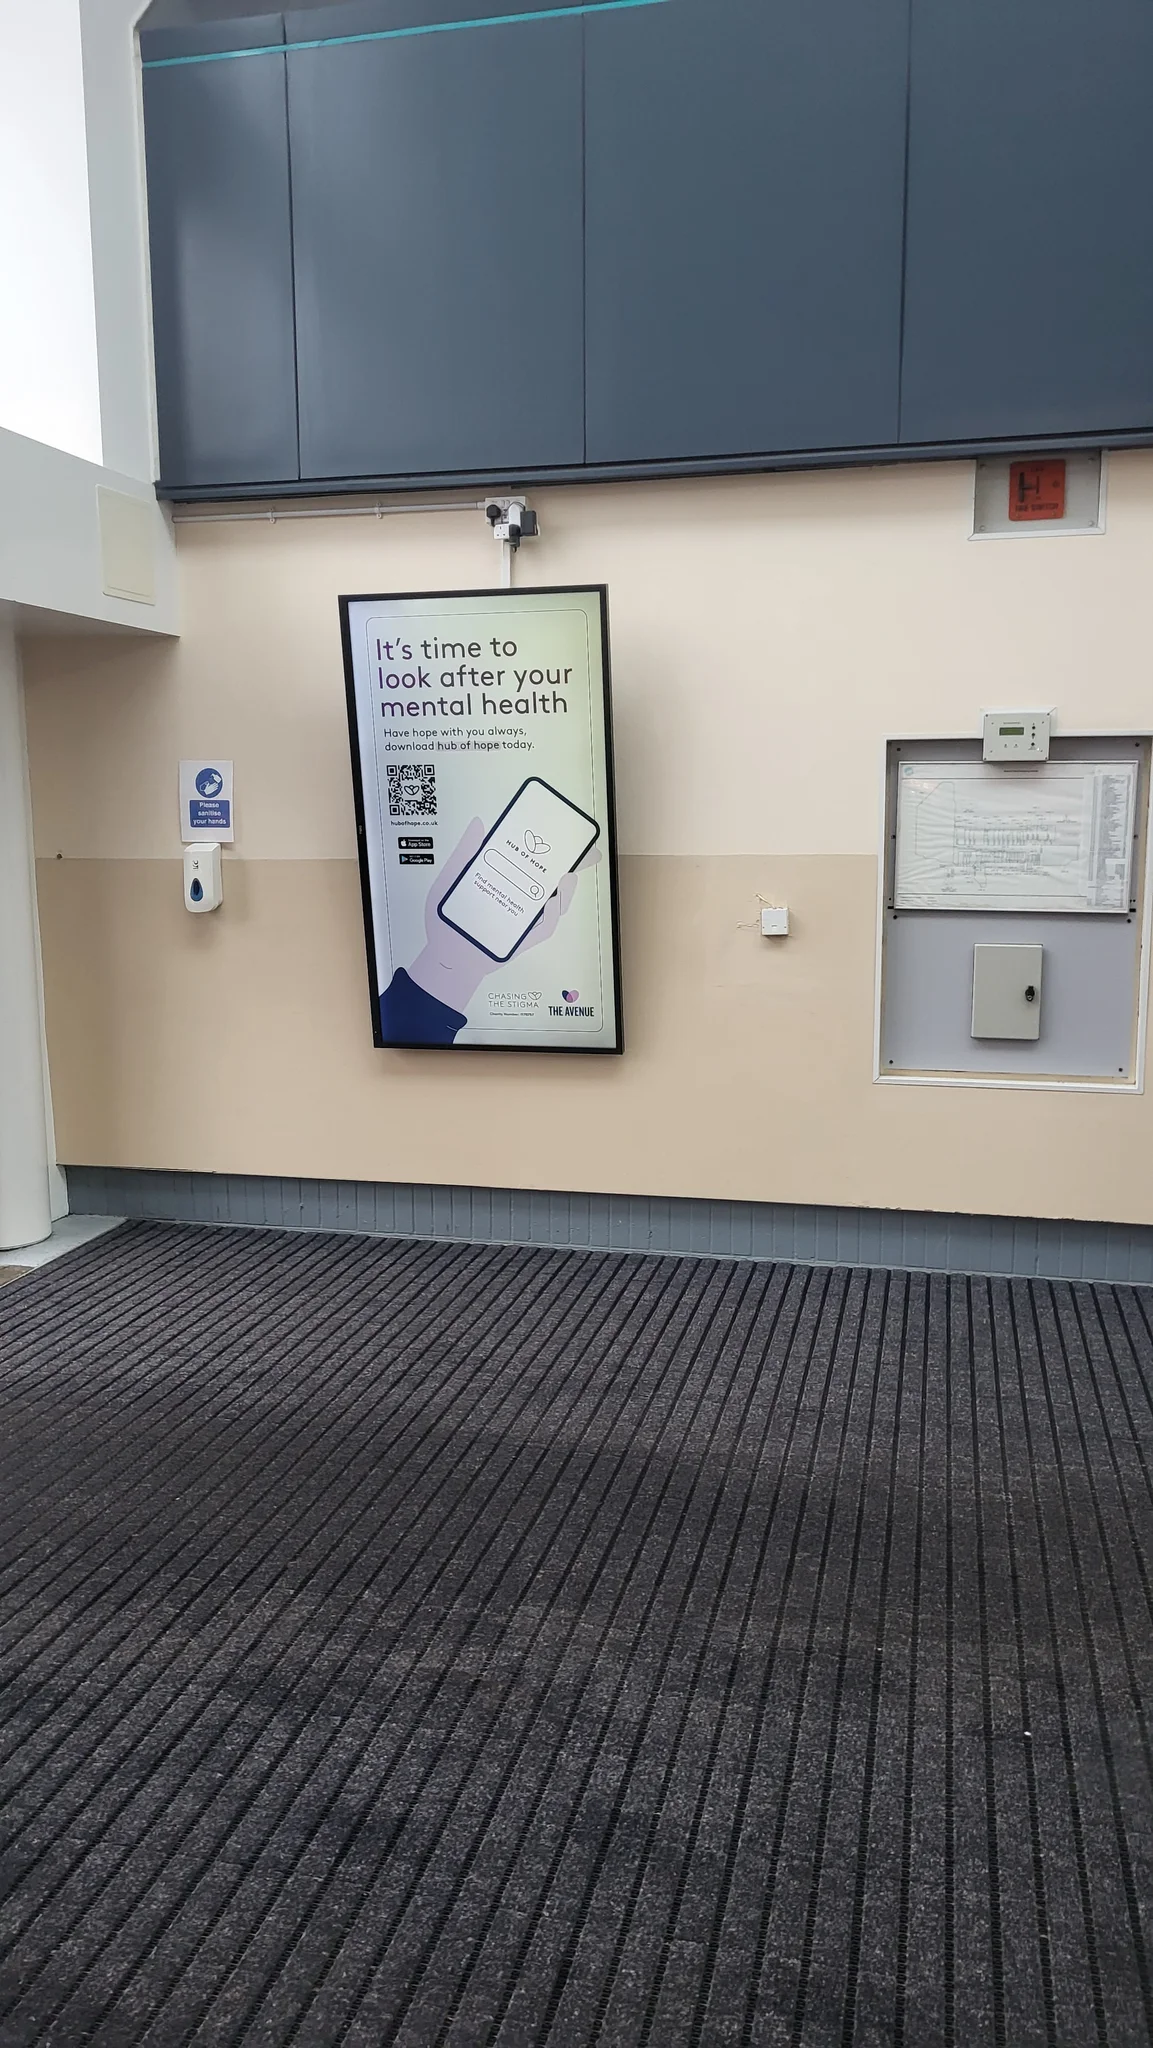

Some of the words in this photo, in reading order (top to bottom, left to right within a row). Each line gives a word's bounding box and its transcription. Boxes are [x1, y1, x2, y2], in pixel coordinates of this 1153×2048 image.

[376, 637, 413, 661] It’s
[420, 636, 482, 660] time
[489, 637, 518, 657] to
[378, 666, 432, 689] look
[440, 664, 505, 687] after
[513, 667, 573, 692] your
[381, 693, 472, 717] mental
[482, 690, 568, 715] health
[384, 728, 410, 738] Have
[412, 727, 438, 740] hope
[440, 727, 464, 737] with
[465, 728, 485, 739] you
[487, 726, 527, 738] always,
[384, 741, 435, 752] download
[437, 741, 457, 750] hub
[460, 740, 471, 750] of
[473, 740, 500, 752] hope
[502, 739, 535, 752] today.
[390, 819, 439, 827] hubofhope.co.uk
[505, 839, 519, 852] HUB
[520, 851, 530, 859] OF
[530, 858, 547, 874] HOPE
[473, 880, 495, 899] support
[494, 897, 508, 908] near
[507, 906, 519, 917] you
[474, 872, 488, 884] Find
[487, 882, 508, 899] mental
[506, 896, 525, 914] health
[488, 992, 527, 1000] CHASING
[548, 1006, 564, 1017] THE
[565, 1006, 595, 1017] AVENUE
